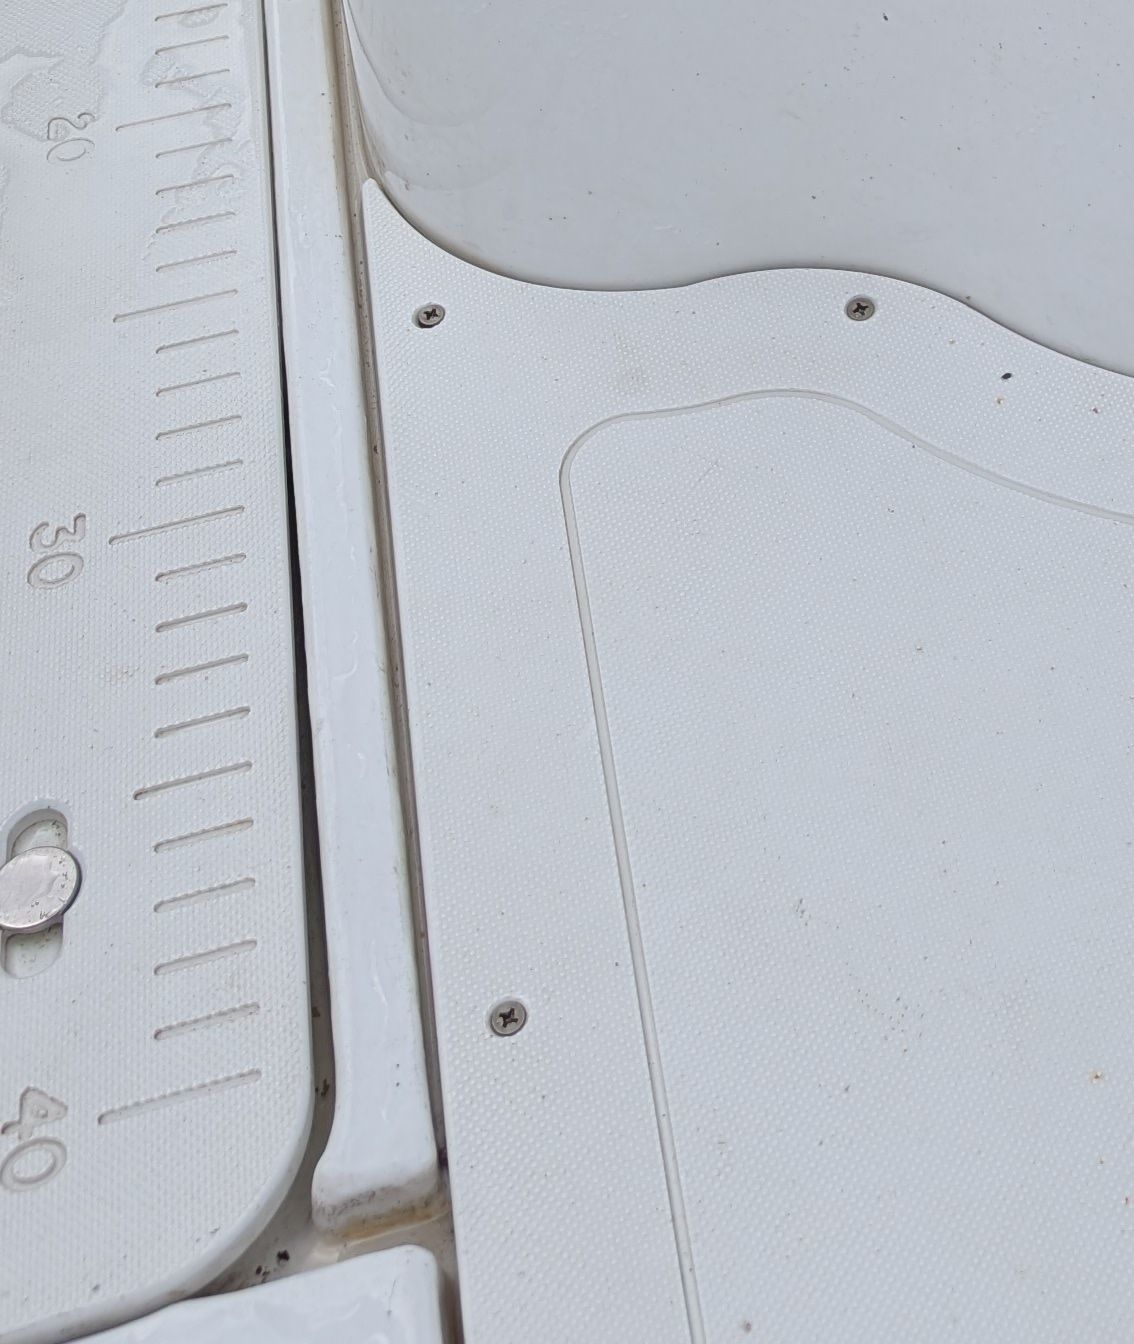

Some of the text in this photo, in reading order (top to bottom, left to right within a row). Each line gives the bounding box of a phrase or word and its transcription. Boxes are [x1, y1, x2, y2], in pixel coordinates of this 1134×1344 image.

[46, 112, 96, 163] 20
[27, 513, 86, 590] 30
[0, 1086, 69, 1192] 40
